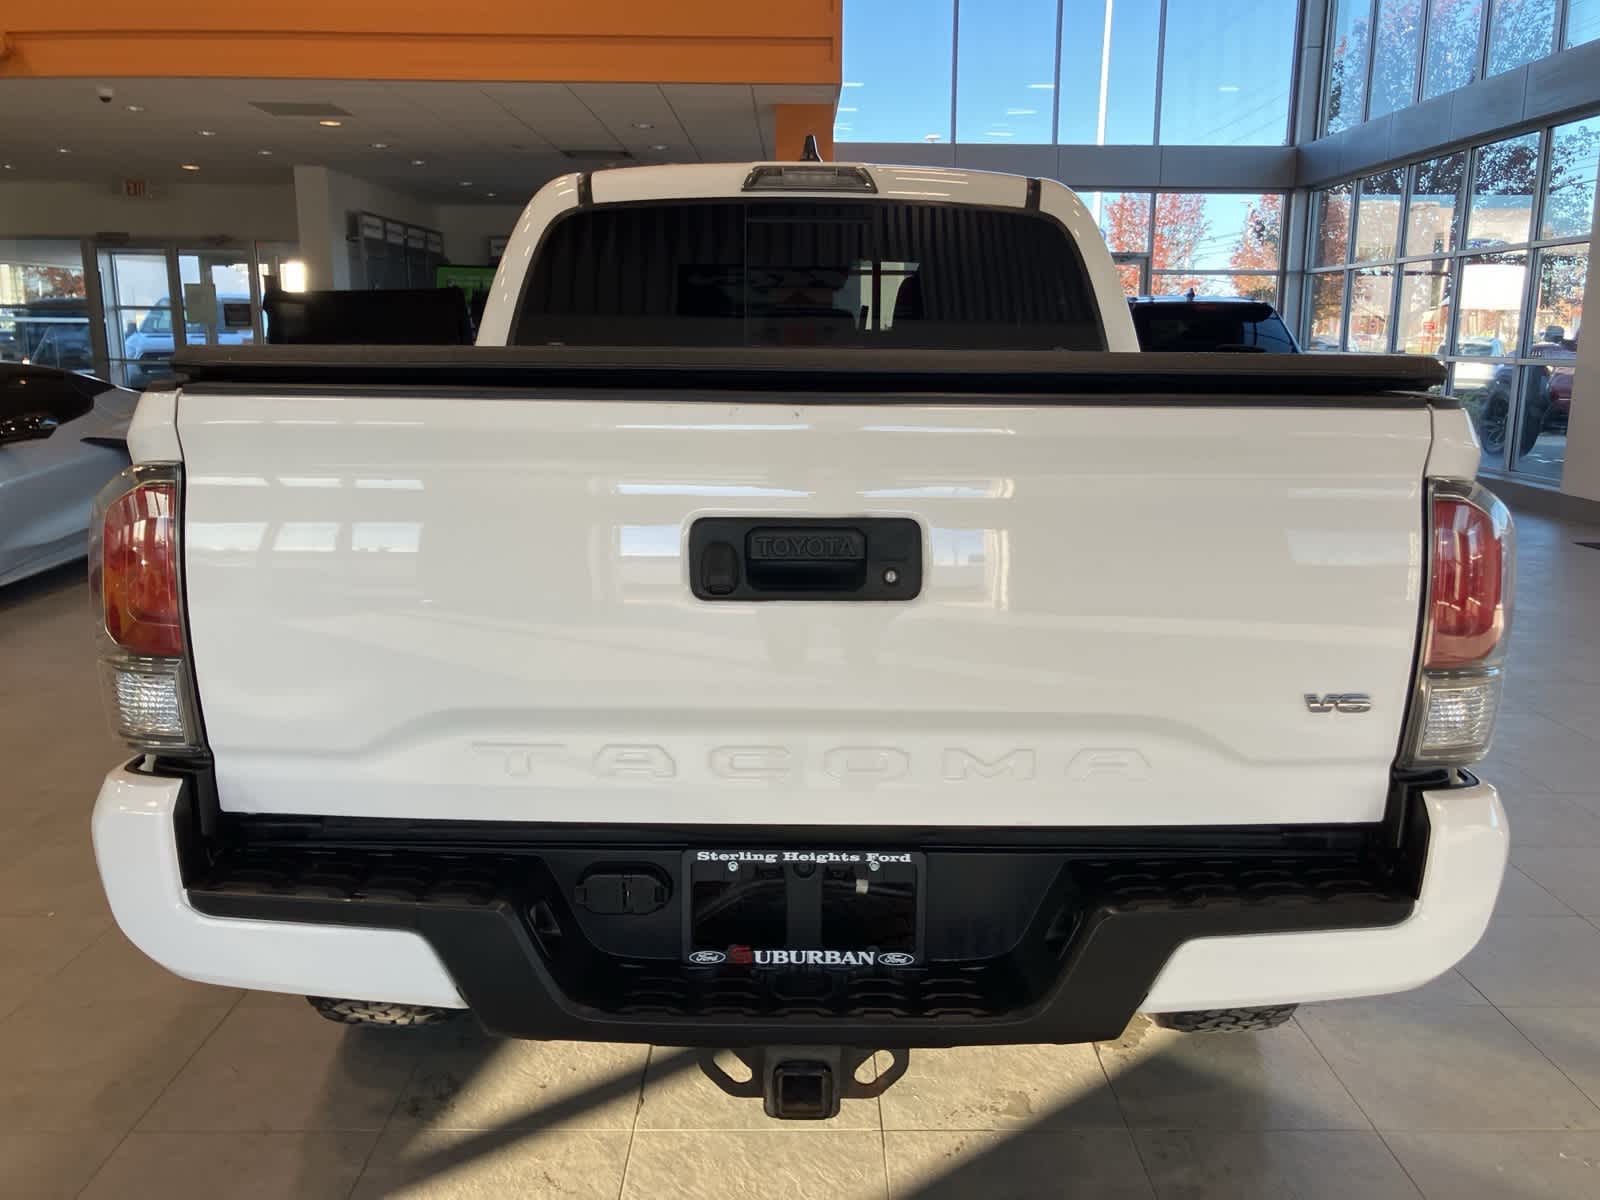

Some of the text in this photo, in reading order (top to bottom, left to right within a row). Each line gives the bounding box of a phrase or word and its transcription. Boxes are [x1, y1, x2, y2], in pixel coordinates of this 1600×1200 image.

[757, 535, 857, 556] TOYOTA
[1304, 693, 1371, 713] V6
[471, 741, 1153, 783] TACOMA
[697, 851, 912, 863] Sterling Heights Ford
